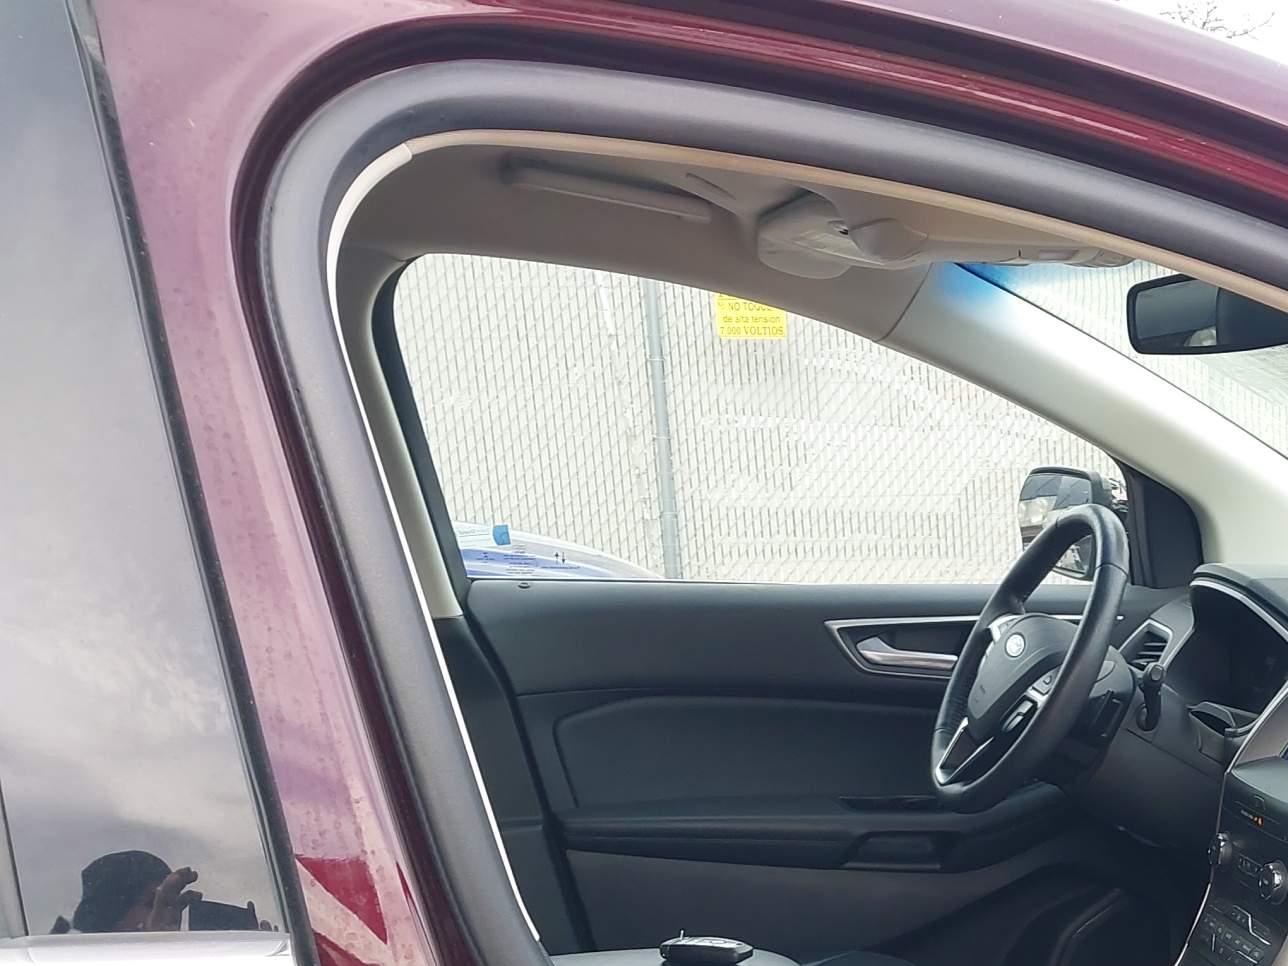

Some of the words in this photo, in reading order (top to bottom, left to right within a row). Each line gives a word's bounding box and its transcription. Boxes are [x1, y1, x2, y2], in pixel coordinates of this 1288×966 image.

[728, 302, 740, 311] NO
[723, 314, 733, 323] de
[735, 315, 749, 323] alta
[743, 326, 784, 336] VOLTIOS
